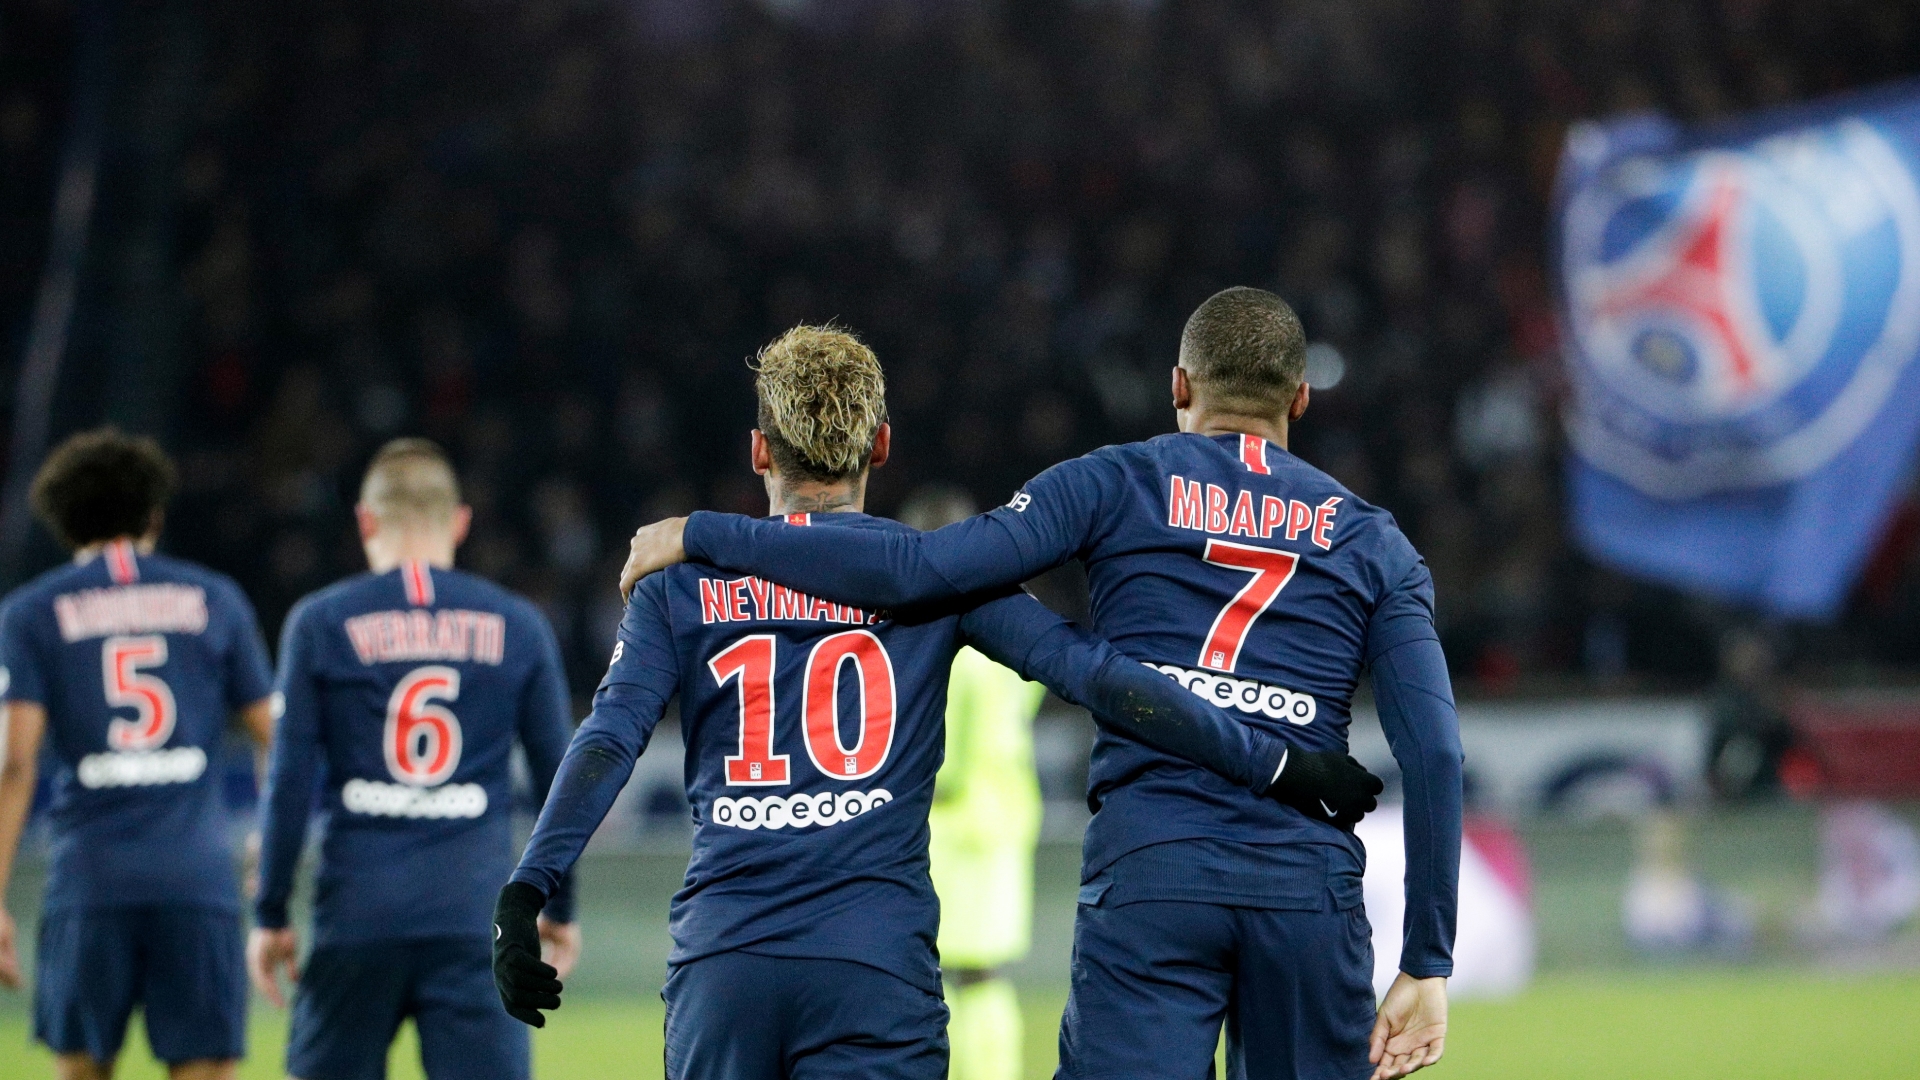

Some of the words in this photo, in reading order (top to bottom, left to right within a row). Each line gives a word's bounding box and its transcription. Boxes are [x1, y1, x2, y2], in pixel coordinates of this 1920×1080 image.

[1168, 474, 1344, 551] MBAPPÉ
[1198, 538, 1299, 674] 7
[103, 635, 176, 751] 5
[384, 666, 462, 786] 6
[707, 629, 897, 786] 10
[1150, 666, 1314, 722] redoo
